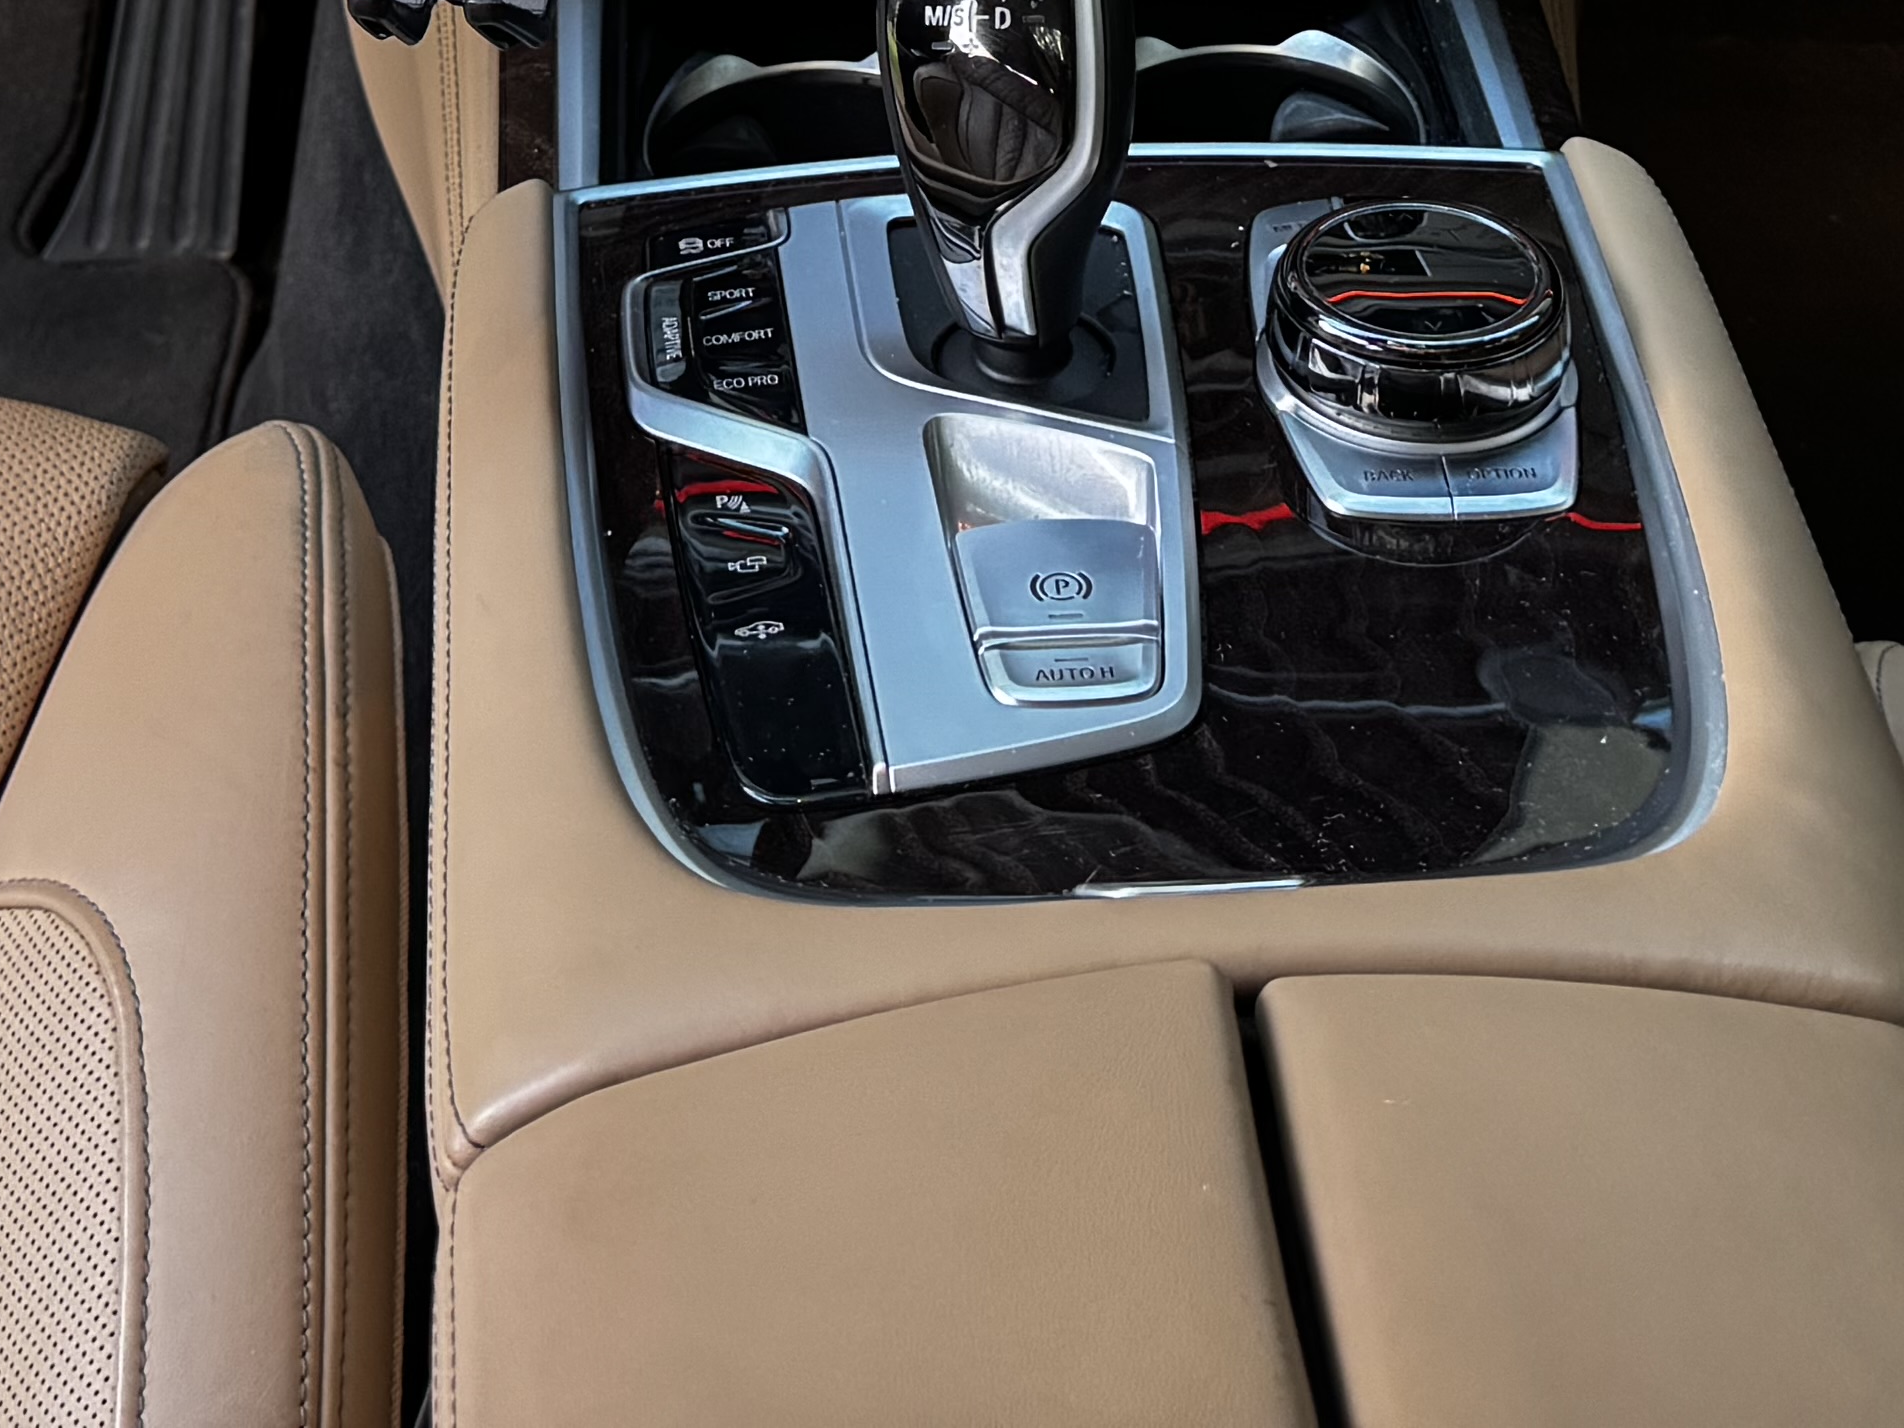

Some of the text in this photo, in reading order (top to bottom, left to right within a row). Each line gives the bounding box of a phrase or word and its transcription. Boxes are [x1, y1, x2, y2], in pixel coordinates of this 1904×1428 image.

[994, 6, 1012, 30] D
[706, 237, 734, 249] OFF
[707, 287, 756, 301] SPORT
[702, 327, 775, 346] COMFORT
[713, 374, 779, 391] ECO PRO
[1466, 466, 1538, 482] OPTION
[1035, 665, 1115, 682] AUTO H
